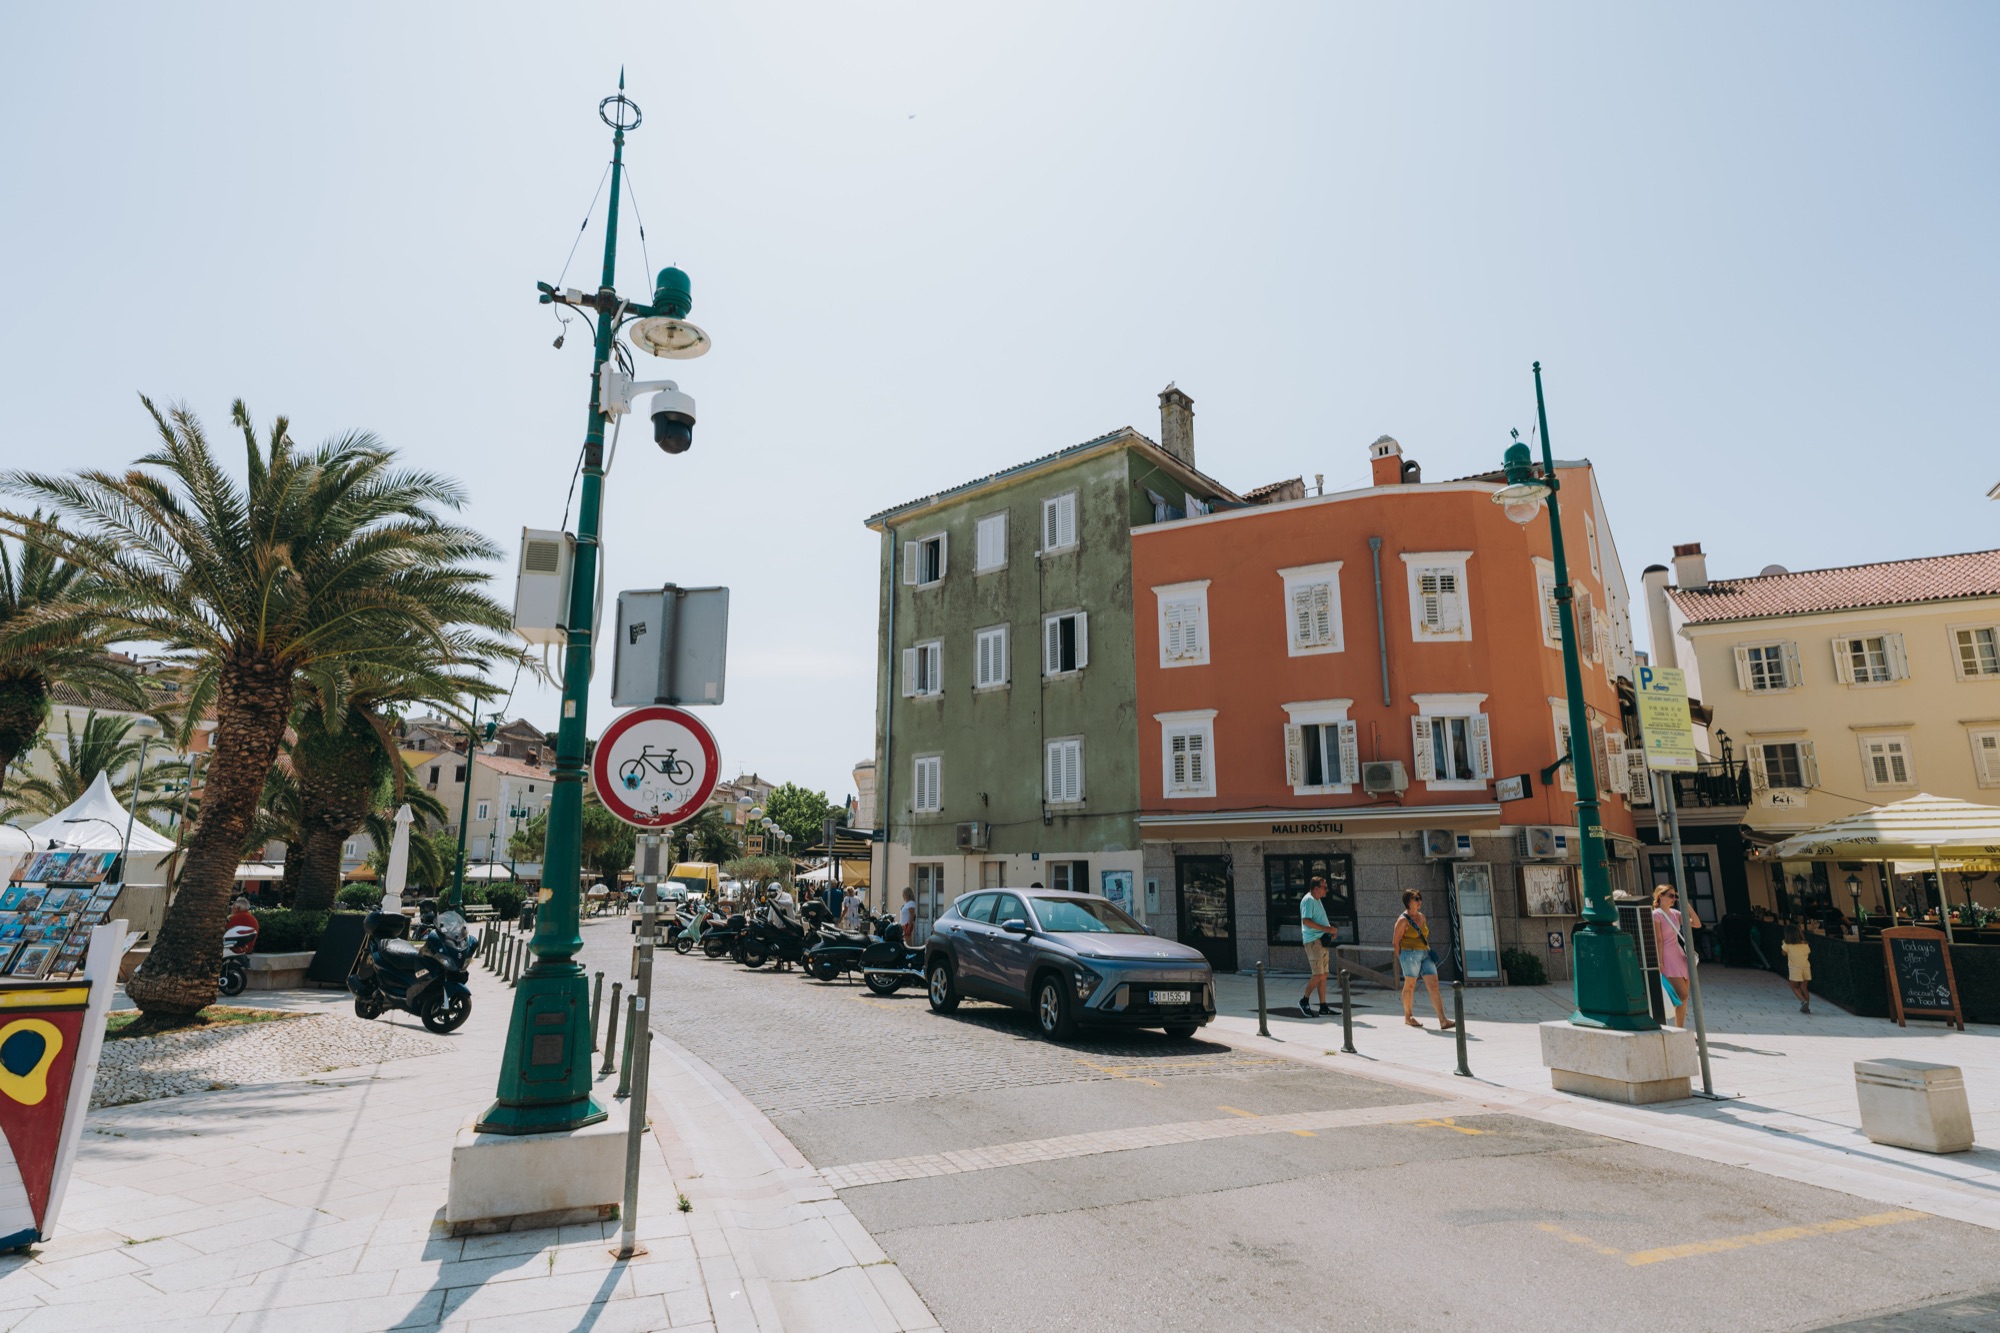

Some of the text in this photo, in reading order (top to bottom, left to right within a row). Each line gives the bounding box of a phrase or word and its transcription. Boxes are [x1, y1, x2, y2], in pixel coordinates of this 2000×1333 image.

[1639, 667, 1653, 690] P
[1272, 821, 1343, 834] MALI ROŠTILJ
[1898, 939, 1936, 957] Today's
